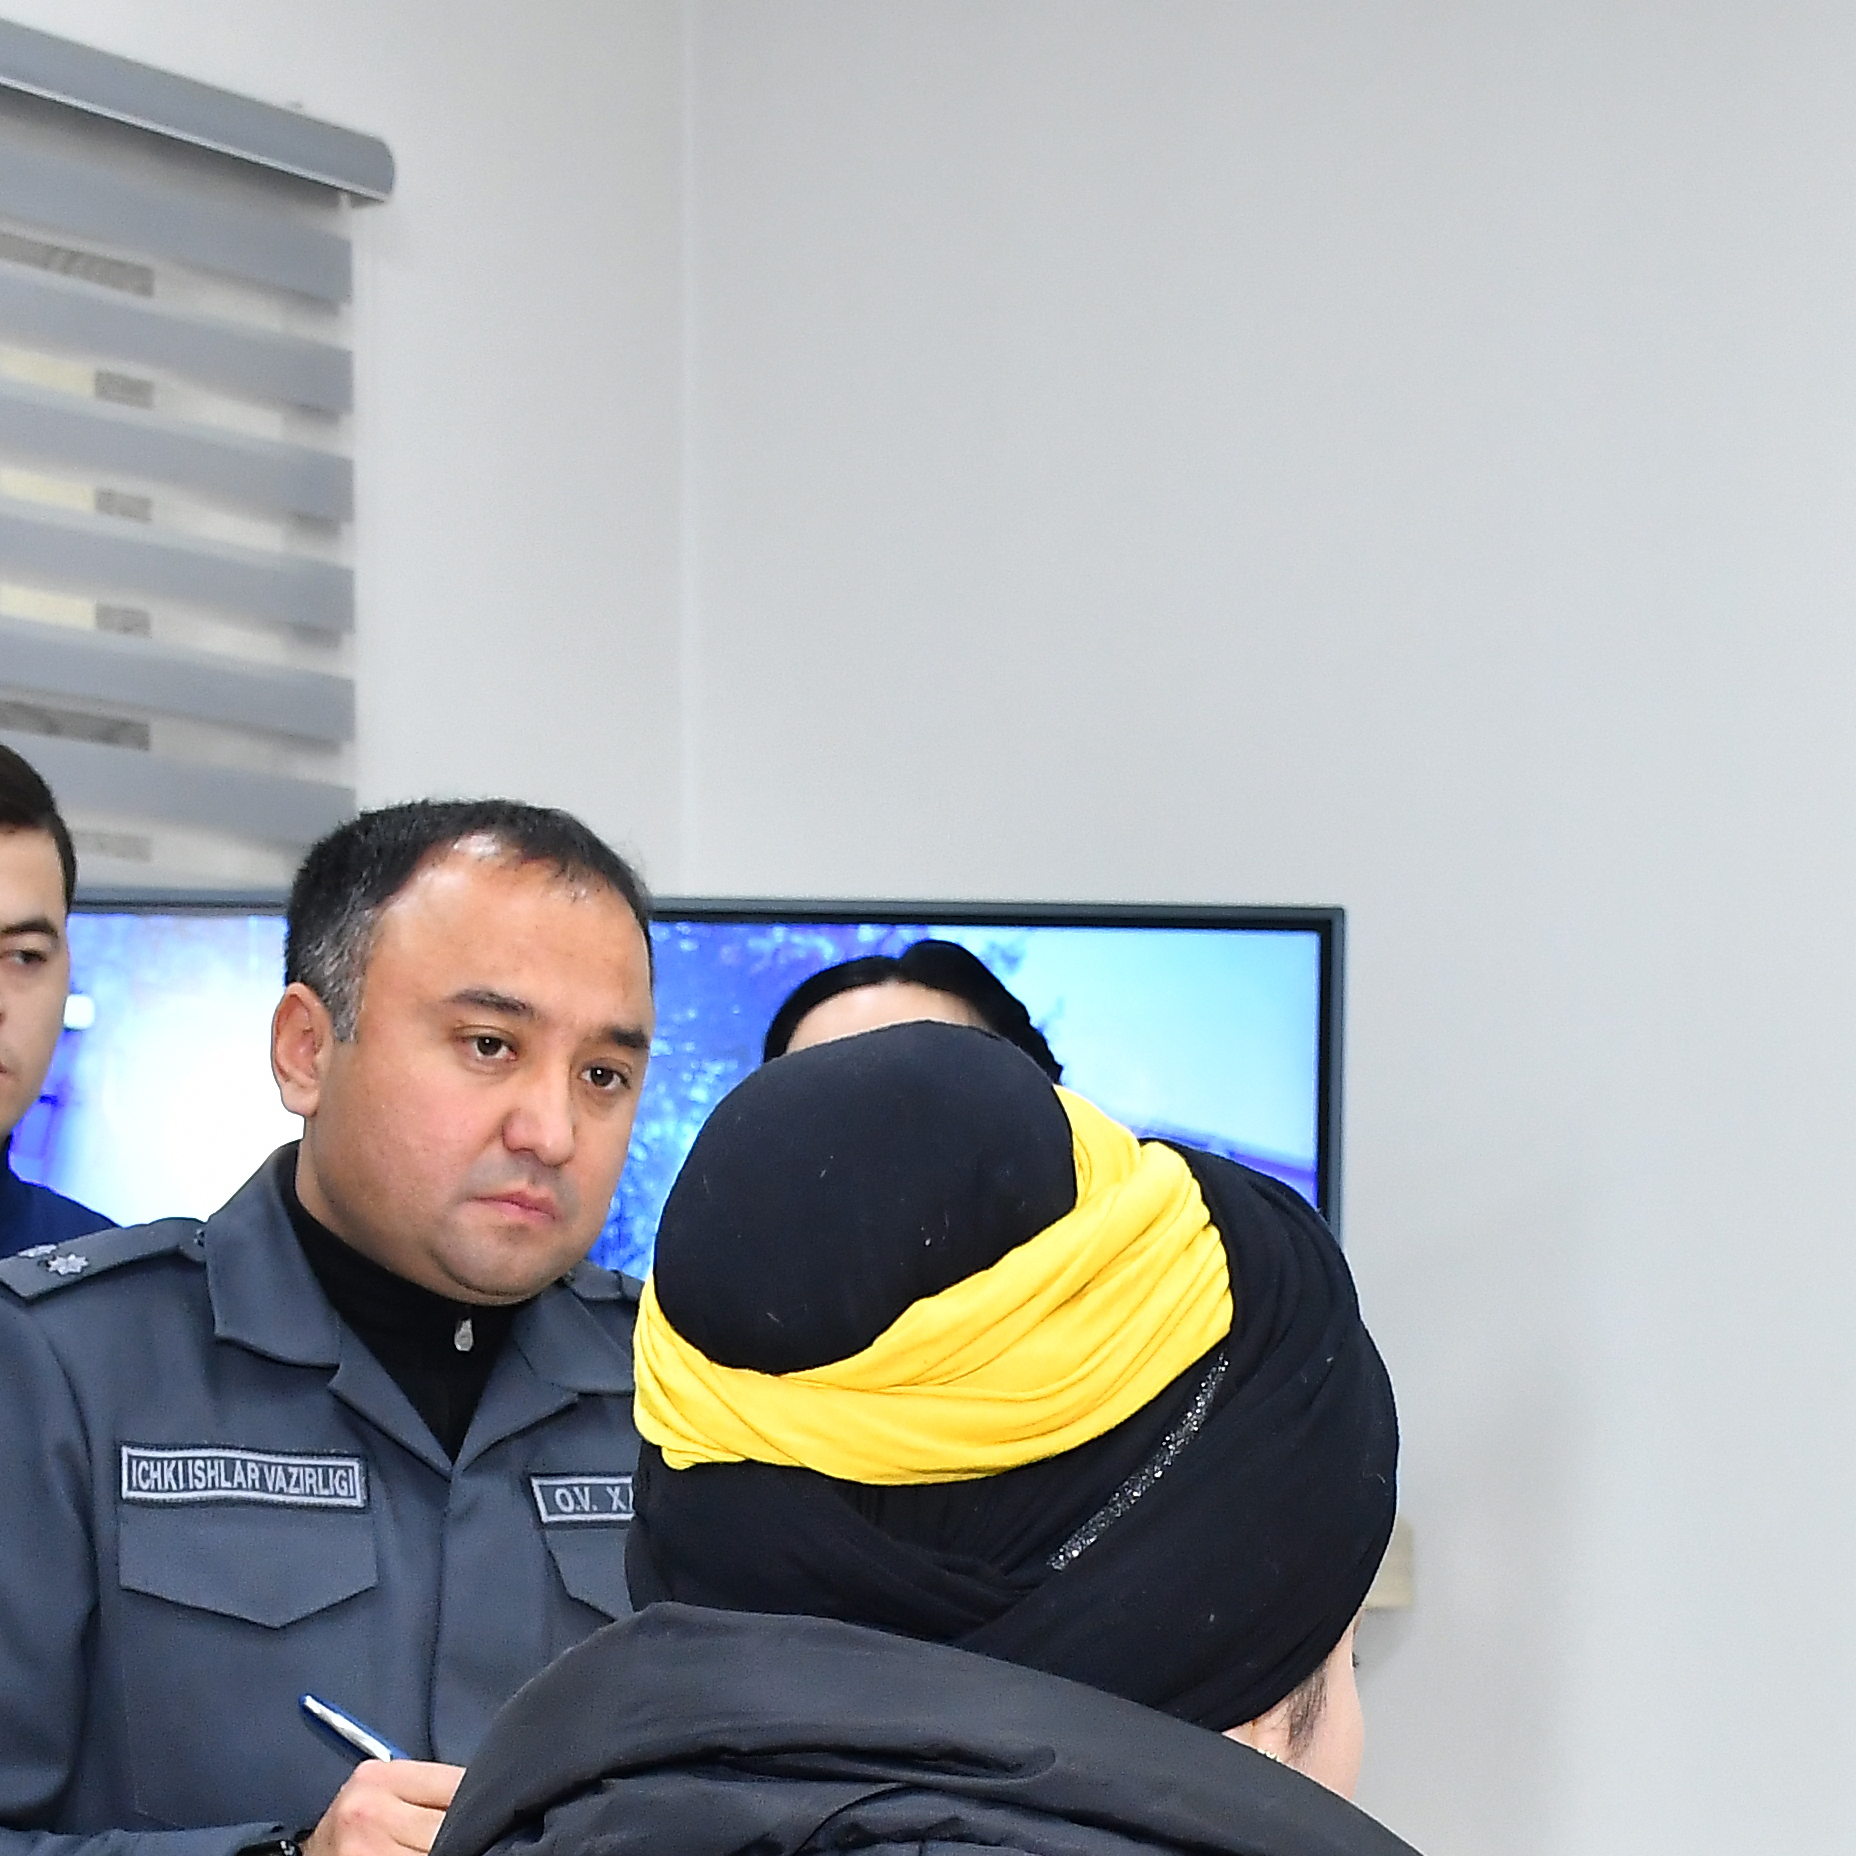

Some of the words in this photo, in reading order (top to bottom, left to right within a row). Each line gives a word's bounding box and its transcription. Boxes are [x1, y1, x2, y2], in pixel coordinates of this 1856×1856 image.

[131, 1459, 184, 1492] ICHKI
[185, 1458, 260, 1492] ISHLAR
[263, 1464, 355, 1497] VAZIRLIGI
[554, 1486, 598, 1513] O.V.
[605, 1485, 634, 1512] X
